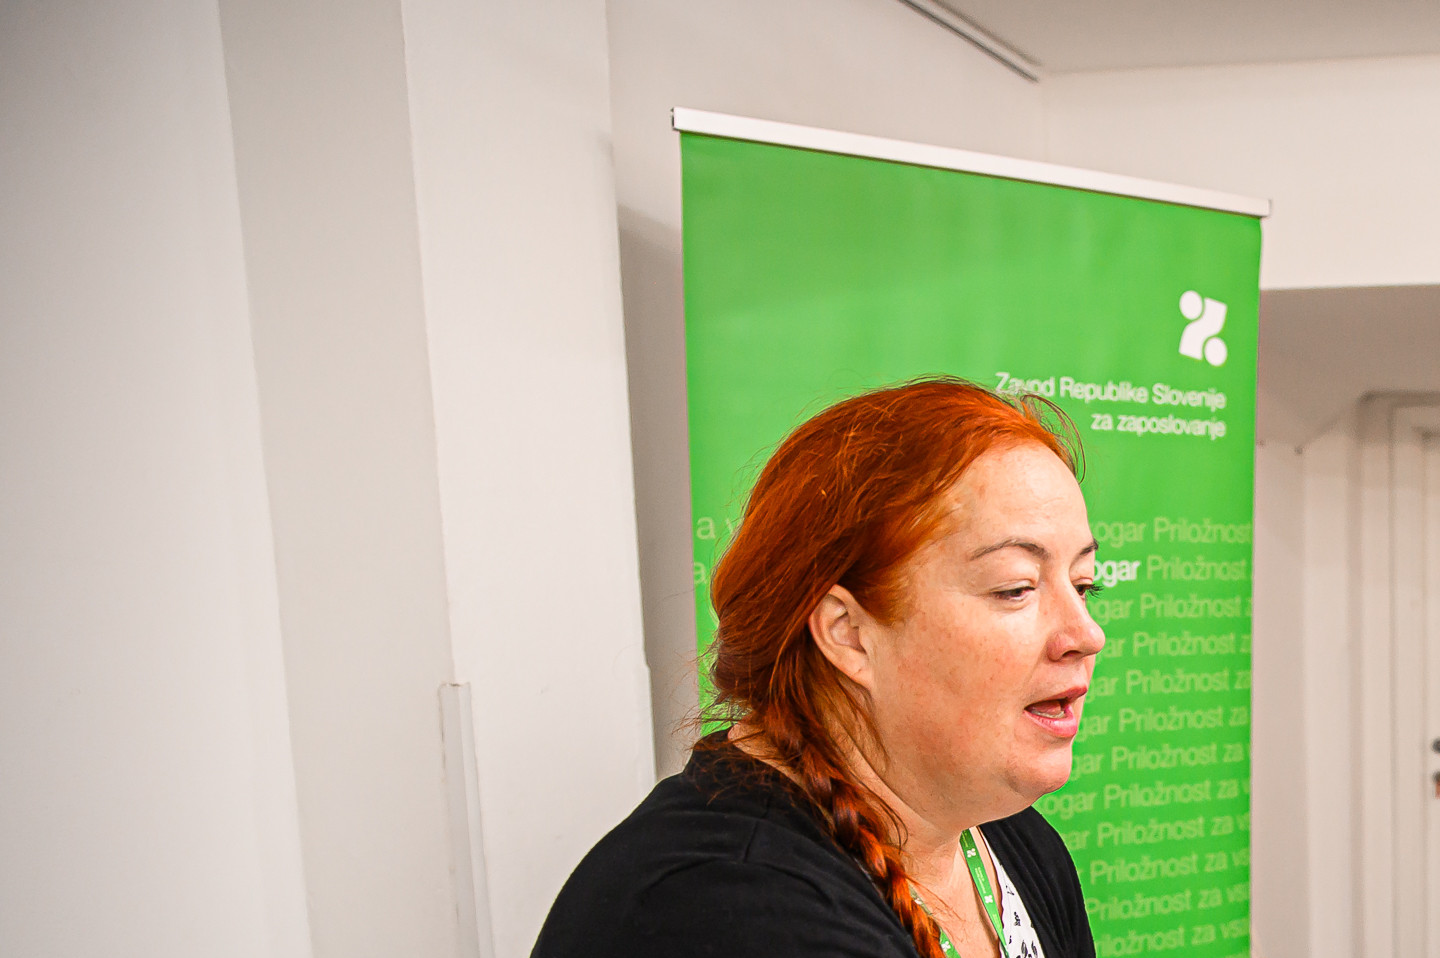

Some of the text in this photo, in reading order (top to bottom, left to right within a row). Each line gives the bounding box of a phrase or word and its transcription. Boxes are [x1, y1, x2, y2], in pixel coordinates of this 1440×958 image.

[995, 372, 1226, 412] Zavod Republike Slovenije
[1091, 413, 1226, 440] za zaposlovanje
[1094, 521, 1146, 548] ogar
[1147, 555, 1246, 580] Priložnost
[1141, 593, 1241, 618] Priložnost
[1133, 630, 1235, 656] Priložnost
[1126, 667, 1230, 695] Priložnost
[1119, 705, 1223, 732] Priložnost
[1229, 706, 1248, 726] za
[1111, 742, 1217, 771] Priložnost
[1222, 744, 1244, 762] za
[1040, 779, 1239, 820] ogar Priložnost za
[1097, 816, 1205, 847] Priložnost
[1211, 815, 1234, 836] za
[1090, 851, 1198, 885] Priložnost
[1204, 851, 1228, 872] za
[1197, 888, 1222, 909] za
[1097, 925, 1184, 957] iložnost
[1192, 923, 1216, 947] za
